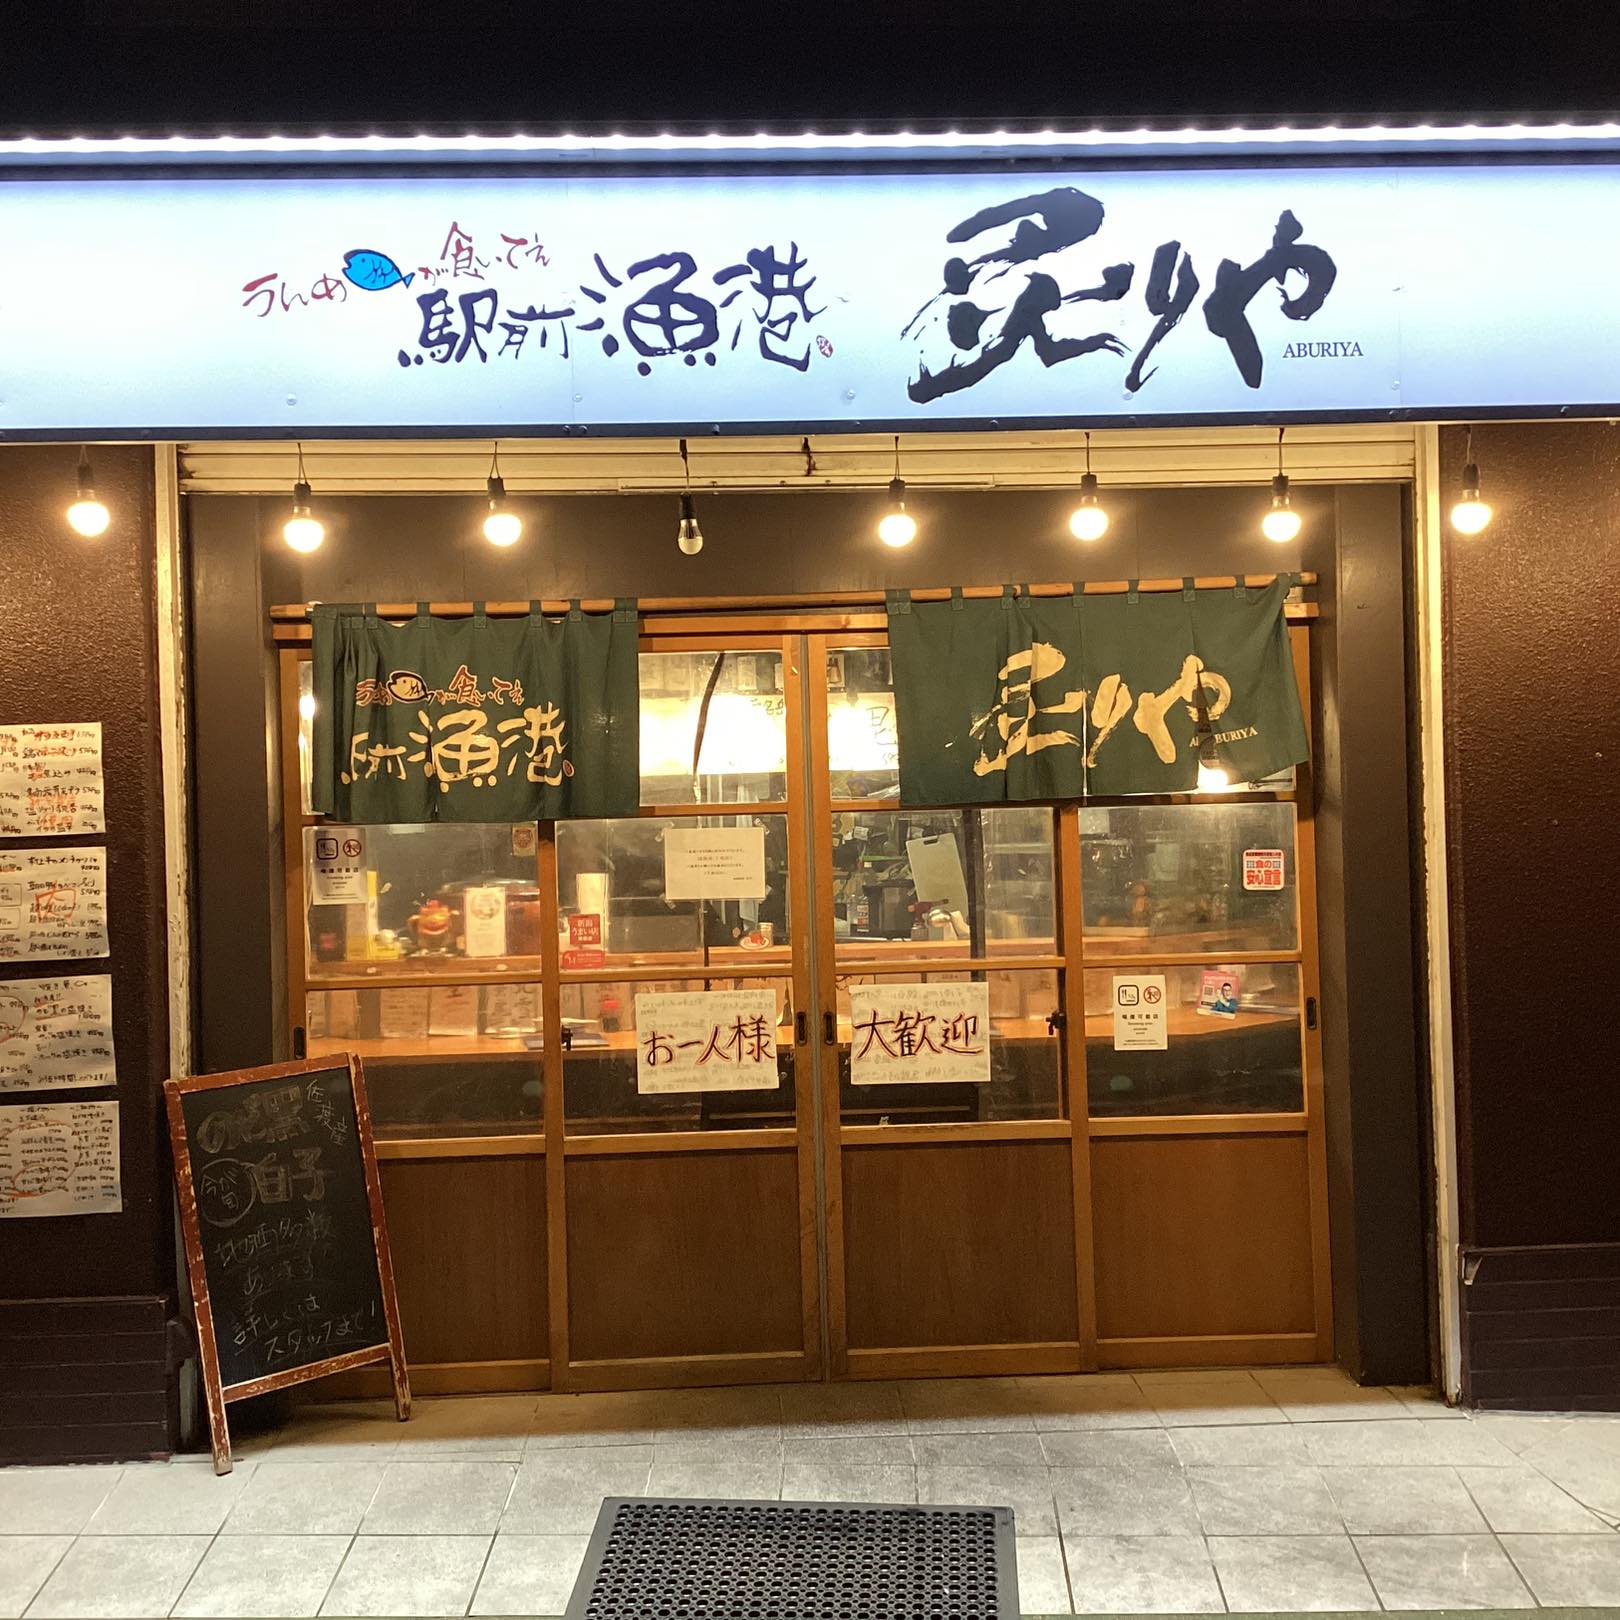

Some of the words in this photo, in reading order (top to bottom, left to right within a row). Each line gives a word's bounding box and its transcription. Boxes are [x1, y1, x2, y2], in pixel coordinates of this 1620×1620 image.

[398, 242, 828, 376] 駅前漁港
[901, 187, 1337, 404] 炙りや
[1282, 341, 1364, 359] ABURIYA
[643, 1014, 776, 1066] お一人様
[854, 1008, 984, 1062] 大歓迎
